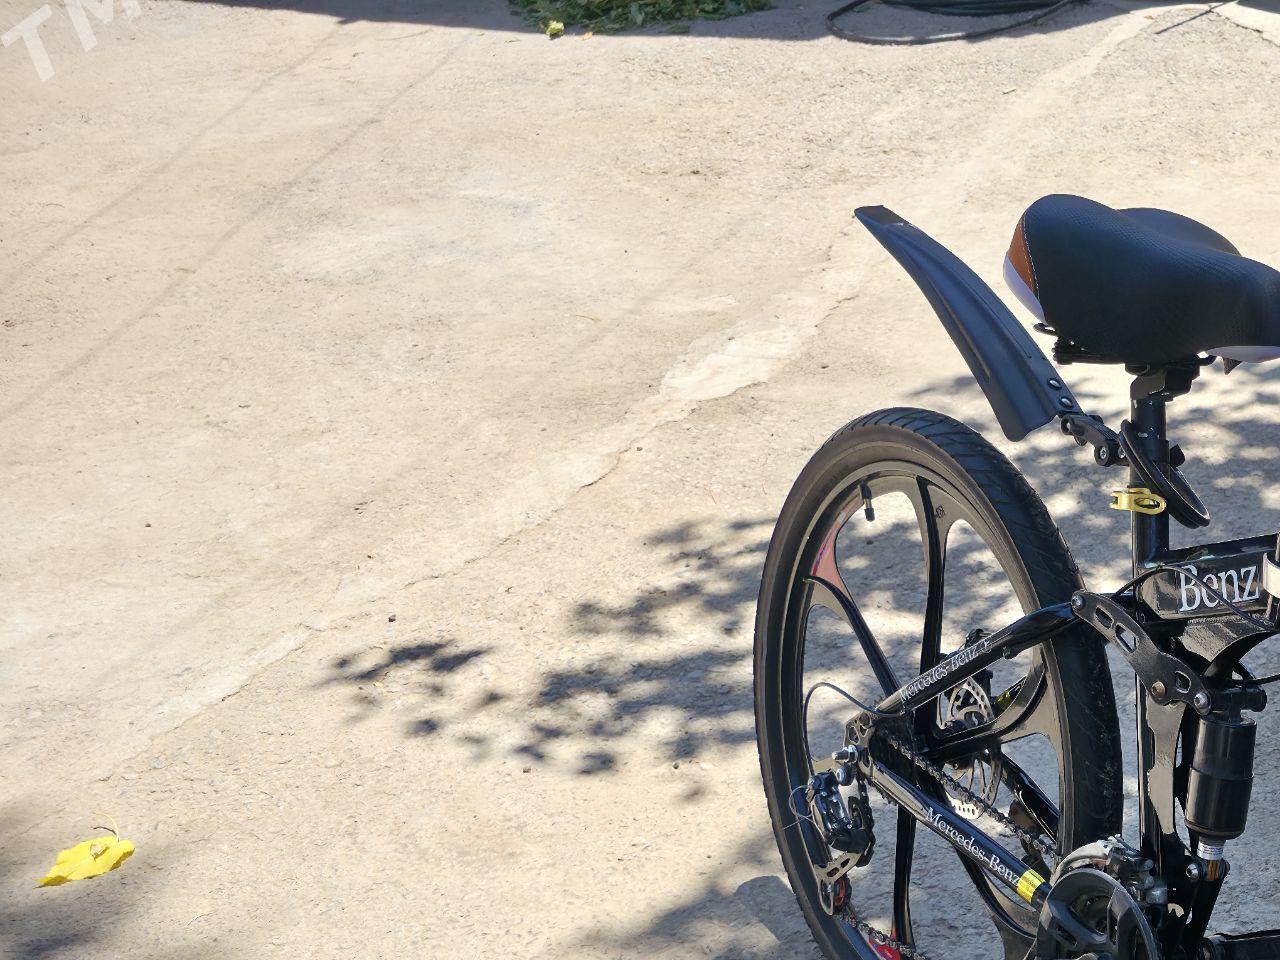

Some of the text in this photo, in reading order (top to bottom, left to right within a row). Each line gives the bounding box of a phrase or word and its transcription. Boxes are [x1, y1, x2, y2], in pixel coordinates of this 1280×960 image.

[1179, 565, 1260, 612] Benz
[900, 646, 980, 704] Mercedes-Benz
[926, 807, 1020, 886] Mercedes-Benz
